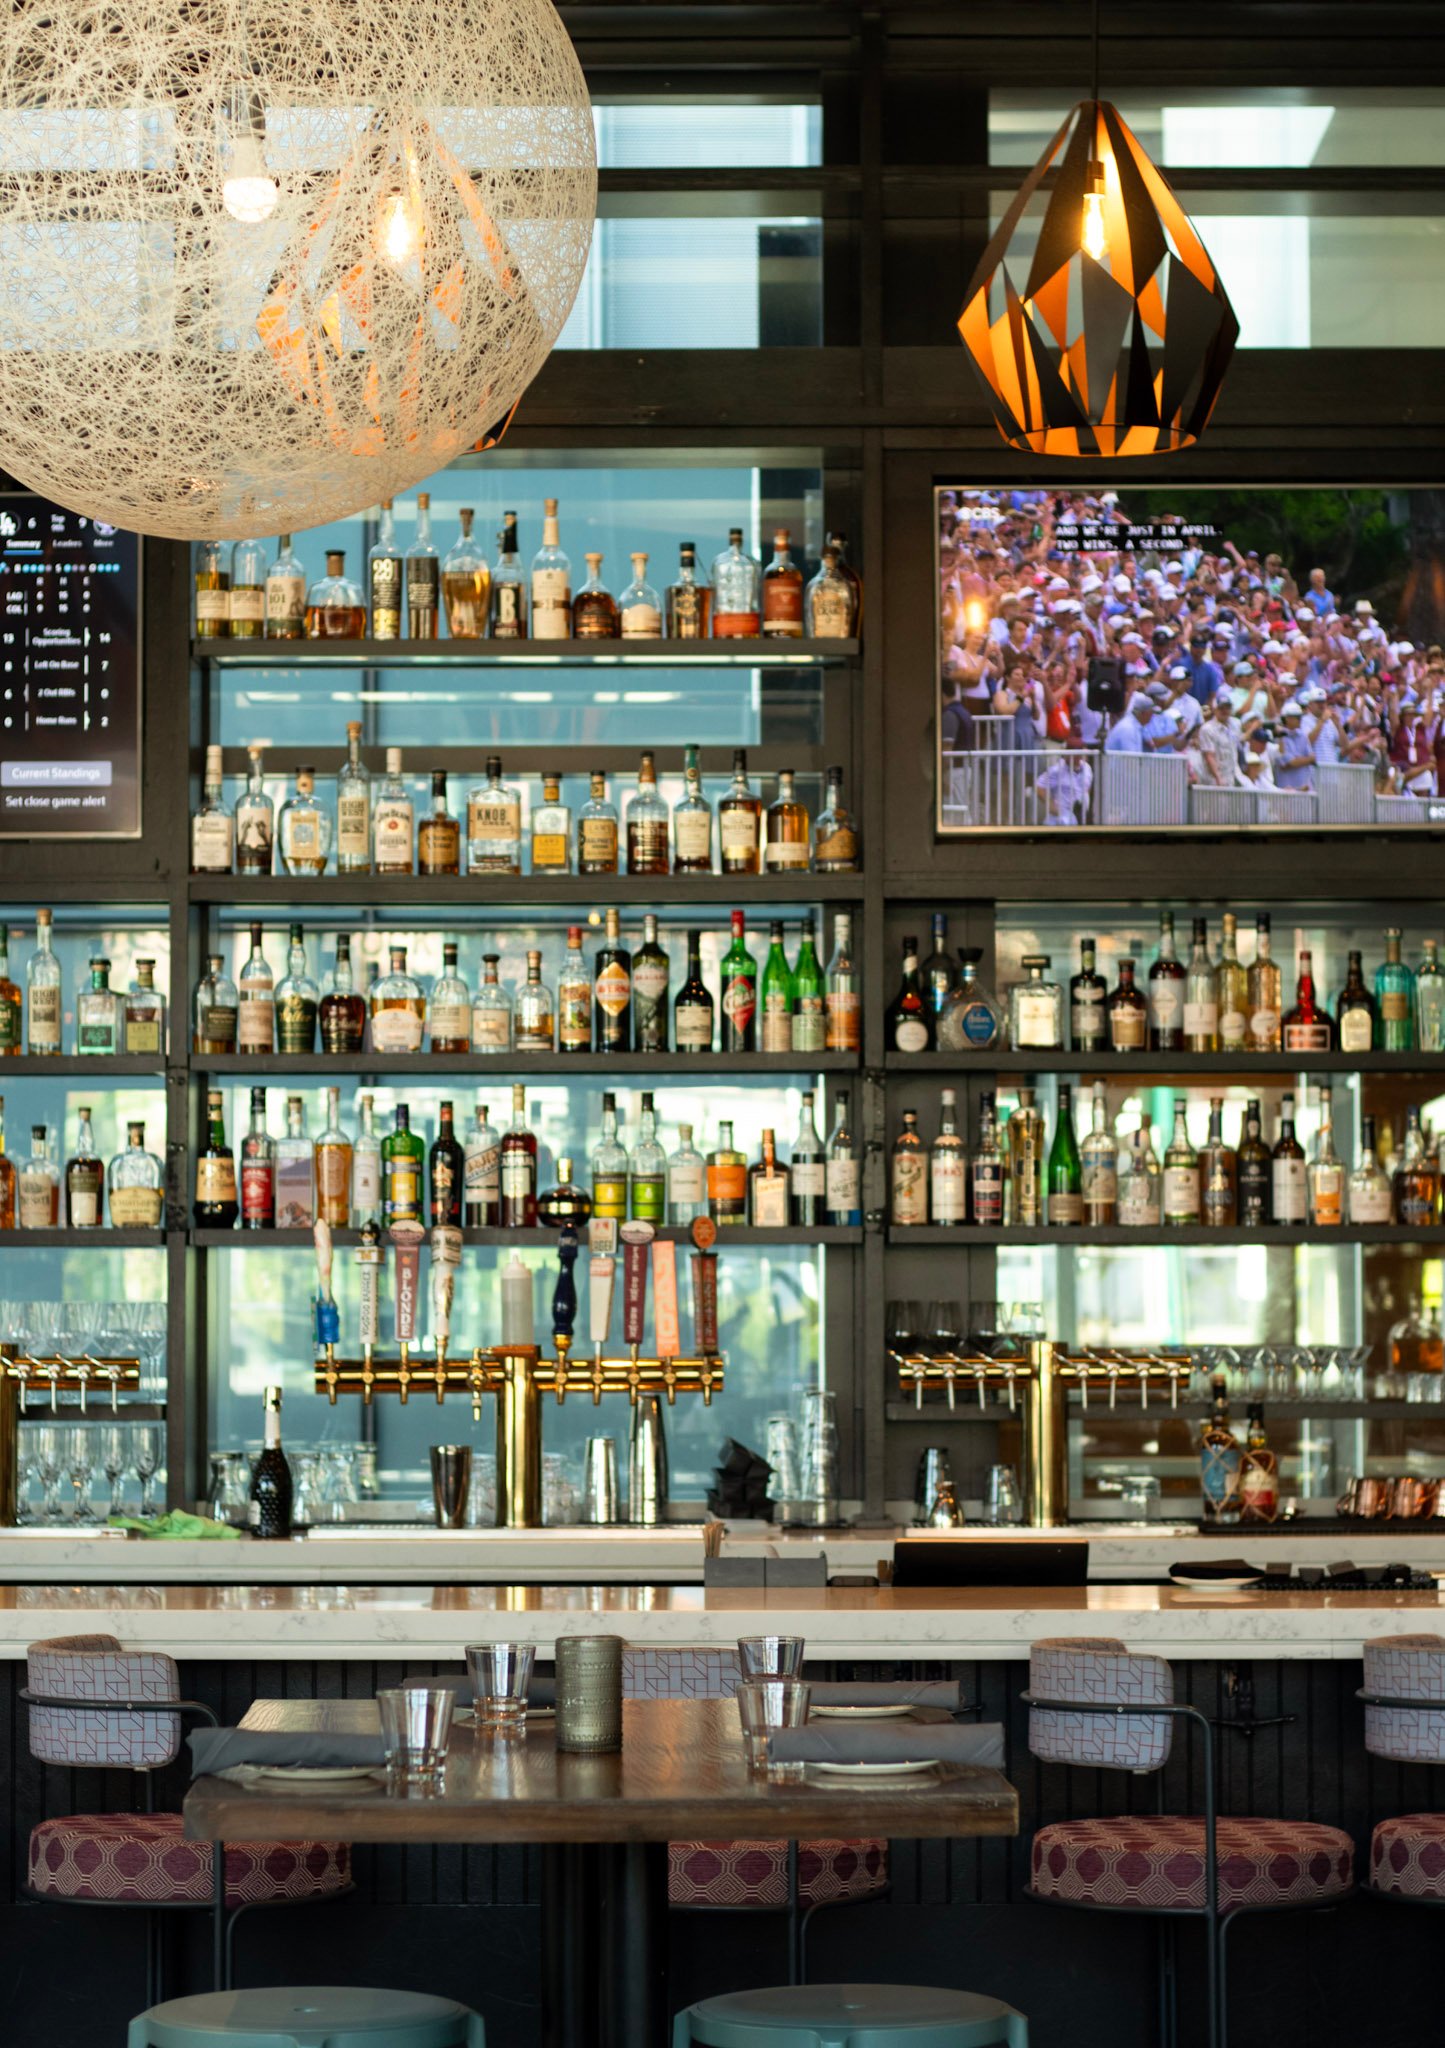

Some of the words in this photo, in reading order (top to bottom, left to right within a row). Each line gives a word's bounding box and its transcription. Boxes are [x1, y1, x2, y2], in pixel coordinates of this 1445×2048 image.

[28, 517, 37, 529] 6
[79, 517, 87, 528] 9
[1056, 526, 1079, 536] AND
[1083, 526, 1119, 536] WE'RE
[1127, 525, 1154, 536] JUST
[1161, 525, 1176, 536] IN
[1181, 525, 1223, 536] APRIL.
[6, 540, 41, 549] Summary
[53, 540, 82, 548] Leaders
[1056, 540, 1079, 550] TWO
[1125, 539, 1134, 550] A
[43, 627, 71, 637] Scoring
[3, 632, 14, 644] 13
[32, 637, 81, 647] Opportunities
[49, 660, 60, 669] On
[61, 660, 79, 669] Base
[101, 660, 109, 671] 7
[36, 716, 57, 725] Home
[58, 716, 77, 725] Runs
[12, 767, 49, 779] Current
[52, 767, 100, 780] Standings
[6, 795, 23, 808] Set
[24, 795, 50, 807] close
[52, 797, 80, 809] game
[82, 795, 105, 807] alert
[477, 808, 506, 821] KNOB
[401, 1267, 412, 1338] BLONDE
